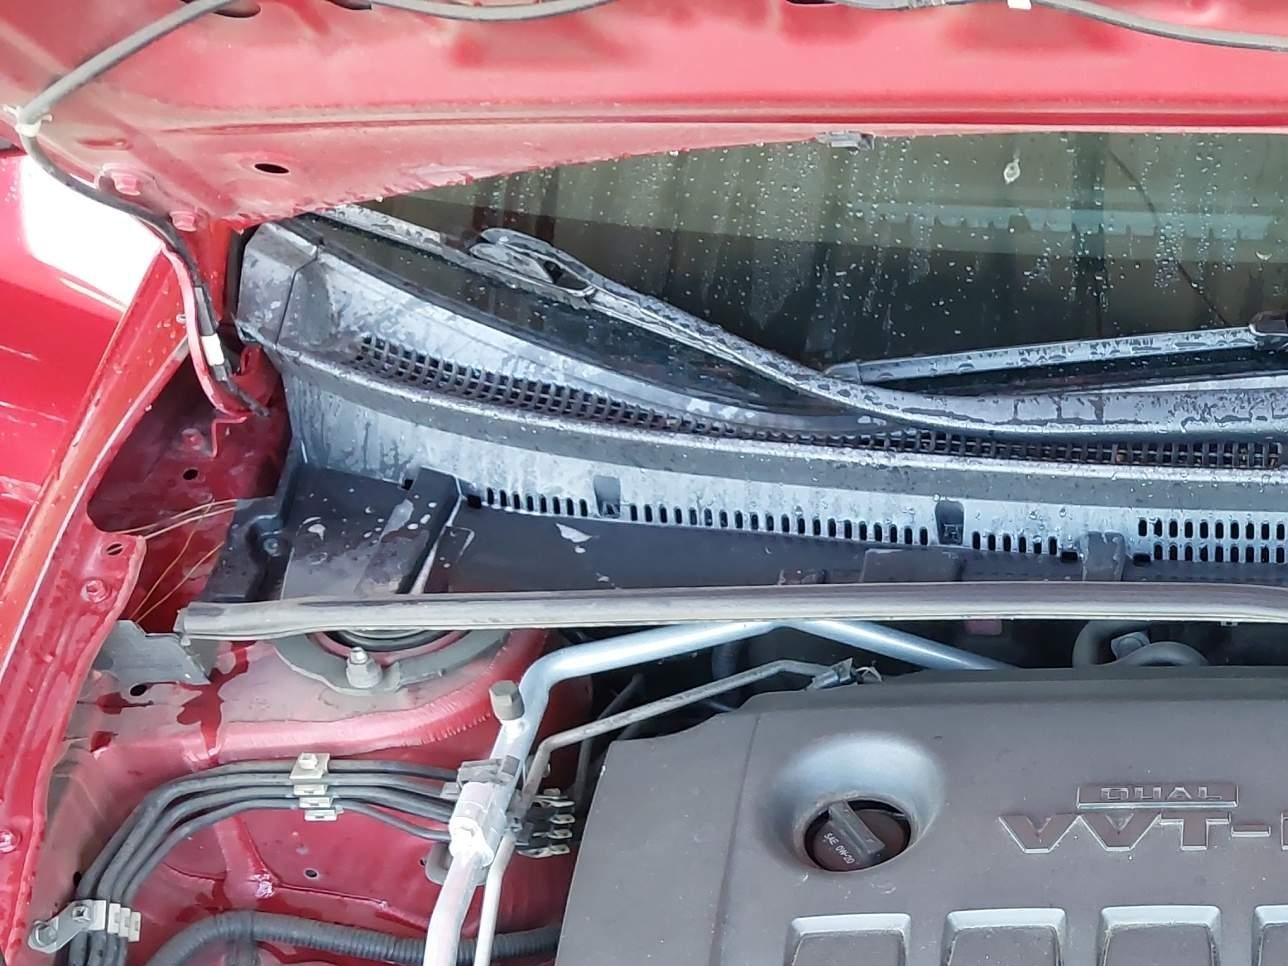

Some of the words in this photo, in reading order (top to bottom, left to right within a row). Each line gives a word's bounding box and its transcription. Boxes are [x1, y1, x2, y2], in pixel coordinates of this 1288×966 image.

[1100, 786, 1223, 800] DUAL
[822, 832, 839, 846] SAE
[835, 845, 856, 864] 0W-20
